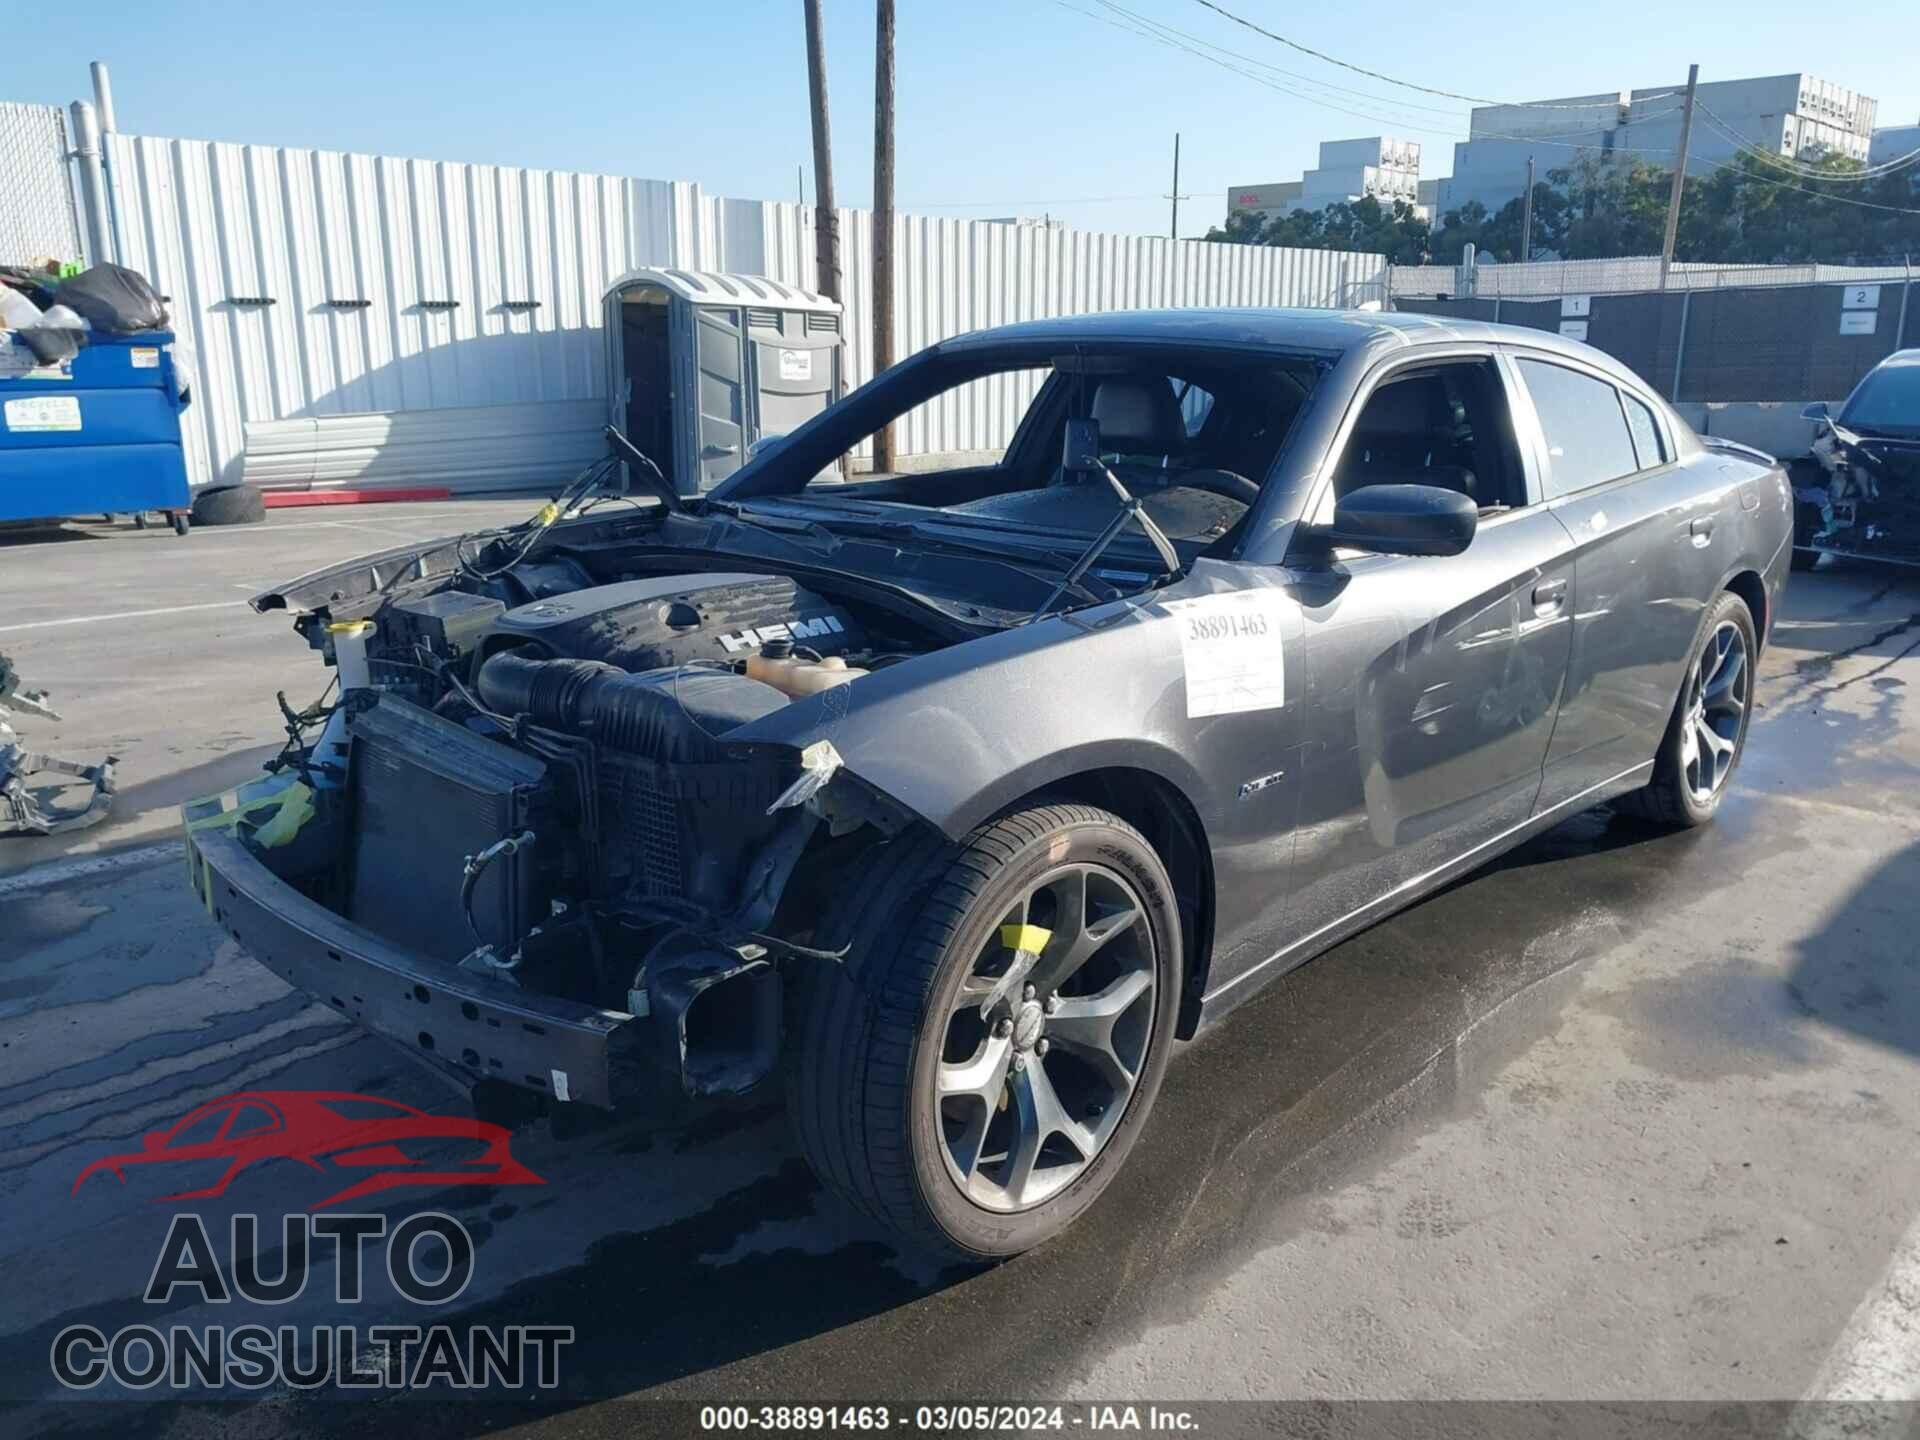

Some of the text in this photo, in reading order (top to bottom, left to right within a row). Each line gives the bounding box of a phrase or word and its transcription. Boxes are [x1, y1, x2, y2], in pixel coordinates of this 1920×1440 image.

[1856, 291, 1866, 303] 2
[719, 615, 844, 652] HEMI
[1188, 613, 1267, 640] 38891463
